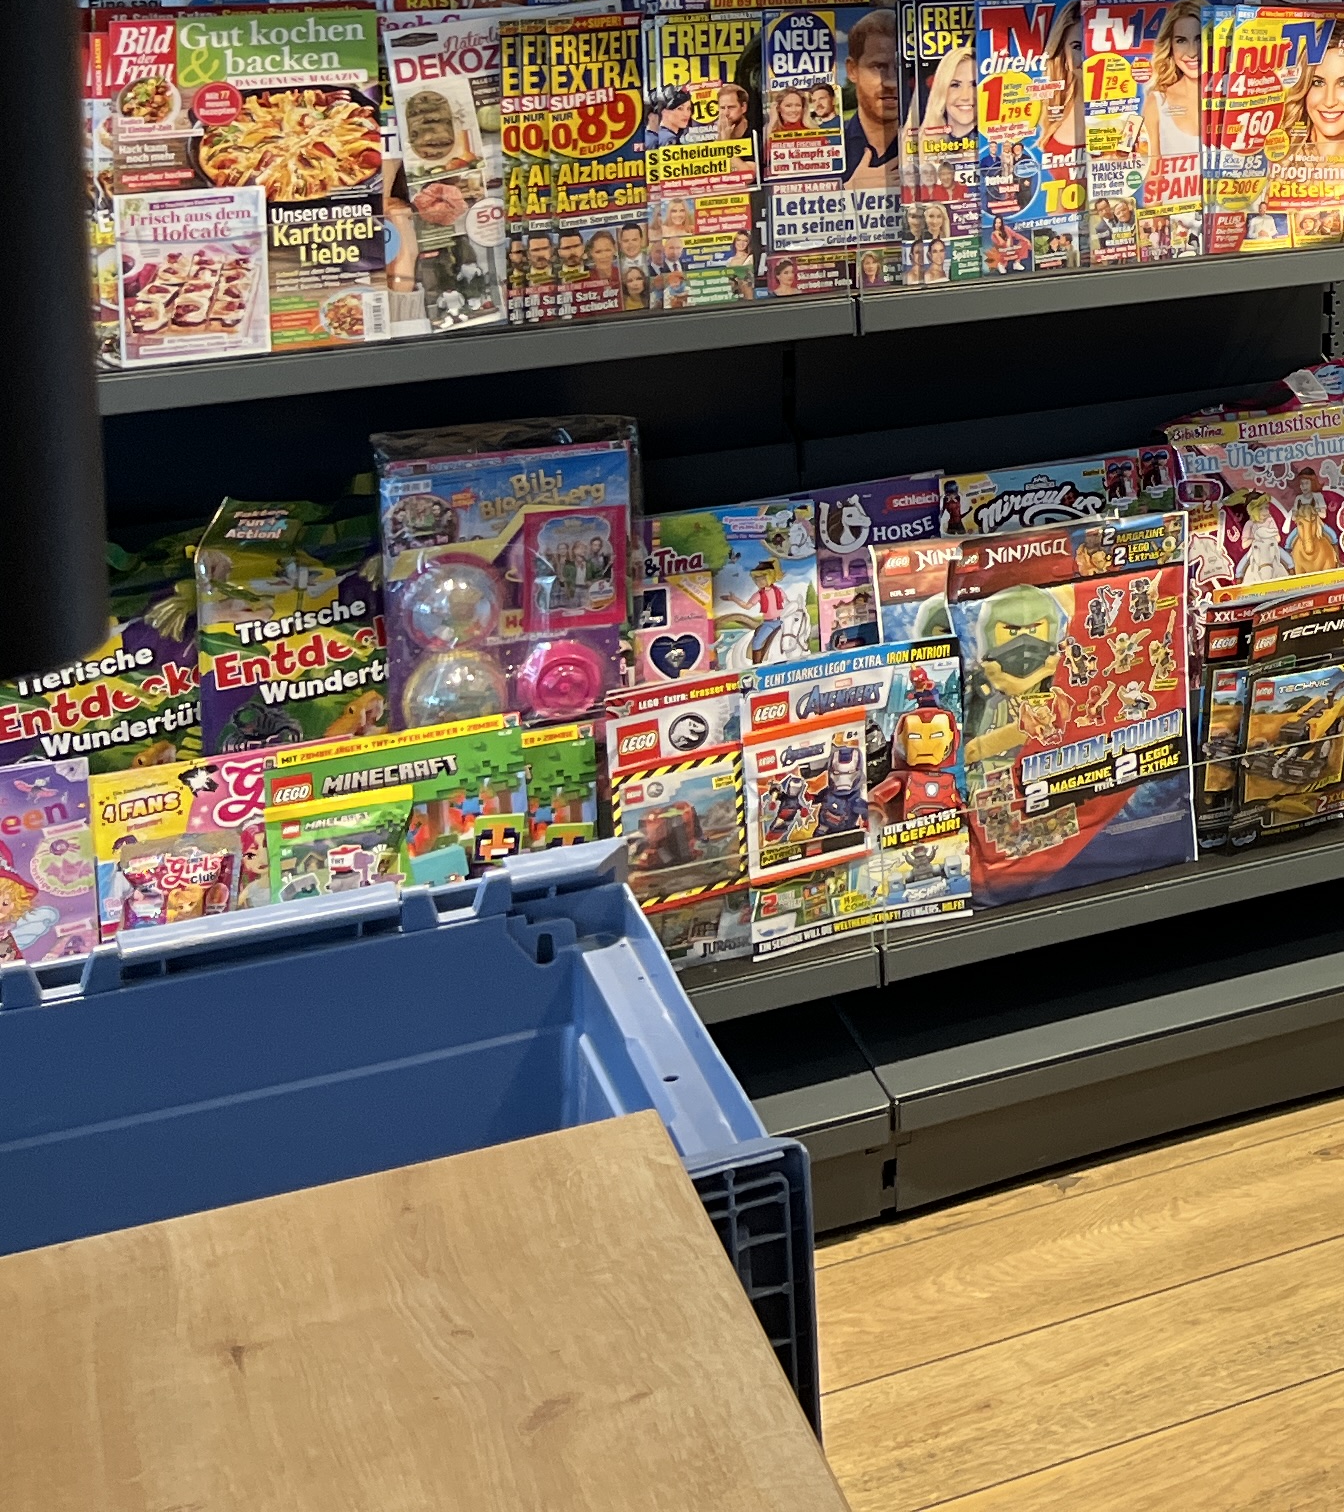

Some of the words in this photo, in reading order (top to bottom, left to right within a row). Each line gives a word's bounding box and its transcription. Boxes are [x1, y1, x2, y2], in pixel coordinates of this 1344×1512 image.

[790, 16, 813, 27] DAS
[115, 27, 170, 55] Bild
[181, 22, 241, 50] Gut
[249, 19, 365, 46] kochen
[775, 30, 830, 51] NEUE
[551, 29, 639, 64] FREIZEIT
[1236, 19, 1336, 72] nurTV
[137, 53, 156, 65] der
[178, 48, 218, 86] &
[225, 49, 341, 74] backen
[773, 51, 833, 74] BLATT
[980, 51, 1048, 74] direkt
[235, 78, 253, 86] DAS
[256, 77, 298, 86] GENUSS
[302, 72, 361, 84] MAGAZIN
[551, 61, 642, 93] EXTRA
[550, 89, 614, 108] SUPER!
[552, 112, 572, 122] NUR
[552, 92, 637, 150] 0,89
[579, 142, 615, 154] EURO
[662, 145, 748, 161] Scheidungs-
[774, 150, 785, 160] So
[788, 149, 824, 161] kämpft
[826, 148, 840, 158] sie
[663, 163, 728, 178] Schlacht!
[774, 162, 789, 170] um
[792, 159, 830, 170] Thomas
[1092, 159, 1145, 173] HAUSHALTS-
[1092, 171, 1124, 182] TRICKS
[271, 208, 329, 224] Unsere
[332, 204, 372, 219] neue
[775, 195, 846, 216] Letztes
[129, 213, 181, 227] Frisch
[185, 212, 209, 222] aus
[214, 208, 252, 220] dem
[152, 221, 232, 241] Hofcafé
[273, 221, 381, 247] Kartoffel-
[300, 242, 359, 264] Liebe
[1239, 409, 1340, 439] Fantastische
[892, 492, 938, 507] schleich
[873, 517, 934, 542] HORSE
[660, 549, 702, 573] Tina
[984, 539, 1069, 568] NINJAGO
[235, 597, 366, 643] Tierische
[764, 672, 786, 688] ECHT
[787, 665, 822, 685] STARKES
[887, 649, 909, 664] IRON
[911, 643, 950, 660] PATRIOT!
[755, 702, 787, 721] LEGO
[1021, 712, 1183, 783] HELDEN-POWER
[322, 754, 458, 794] MINECRAFT
[273, 784, 310, 804] LEGO
[120, 791, 180, 820] FANS
